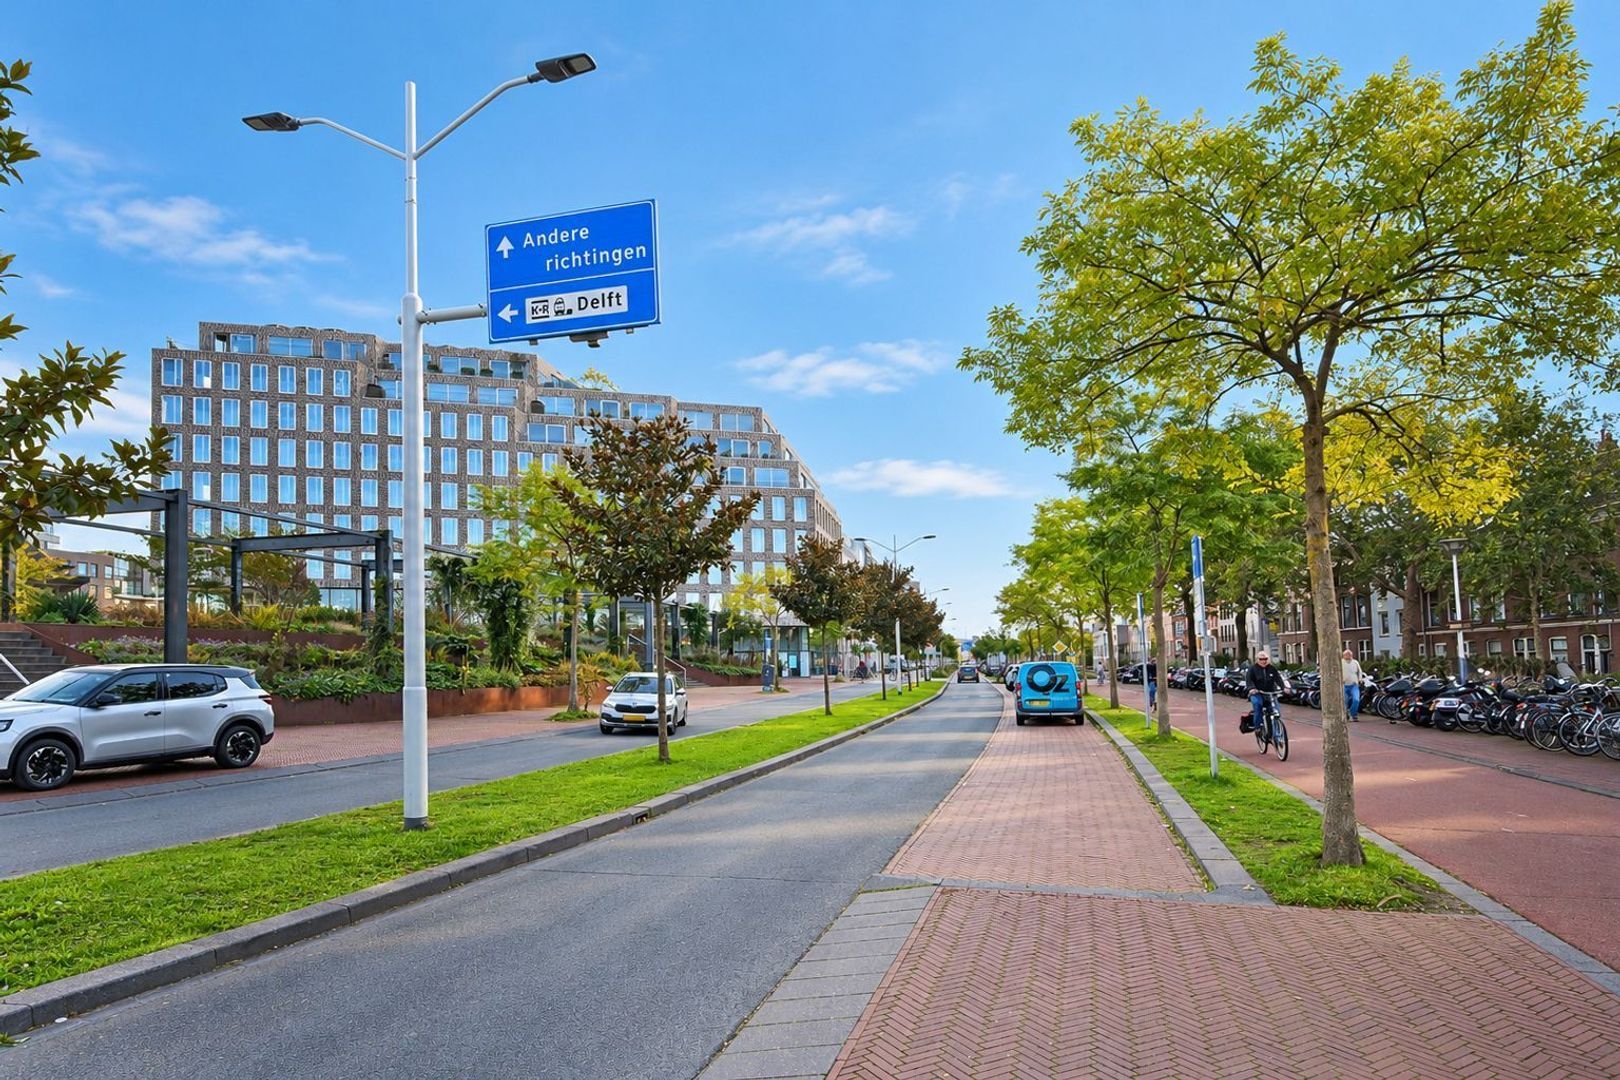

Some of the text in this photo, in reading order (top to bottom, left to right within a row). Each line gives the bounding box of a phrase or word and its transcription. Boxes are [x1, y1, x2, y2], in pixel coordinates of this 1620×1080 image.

[523, 226, 589, 248] Andere
[546, 245, 646, 271] richtingen
[577, 292, 622, 311] Delft
